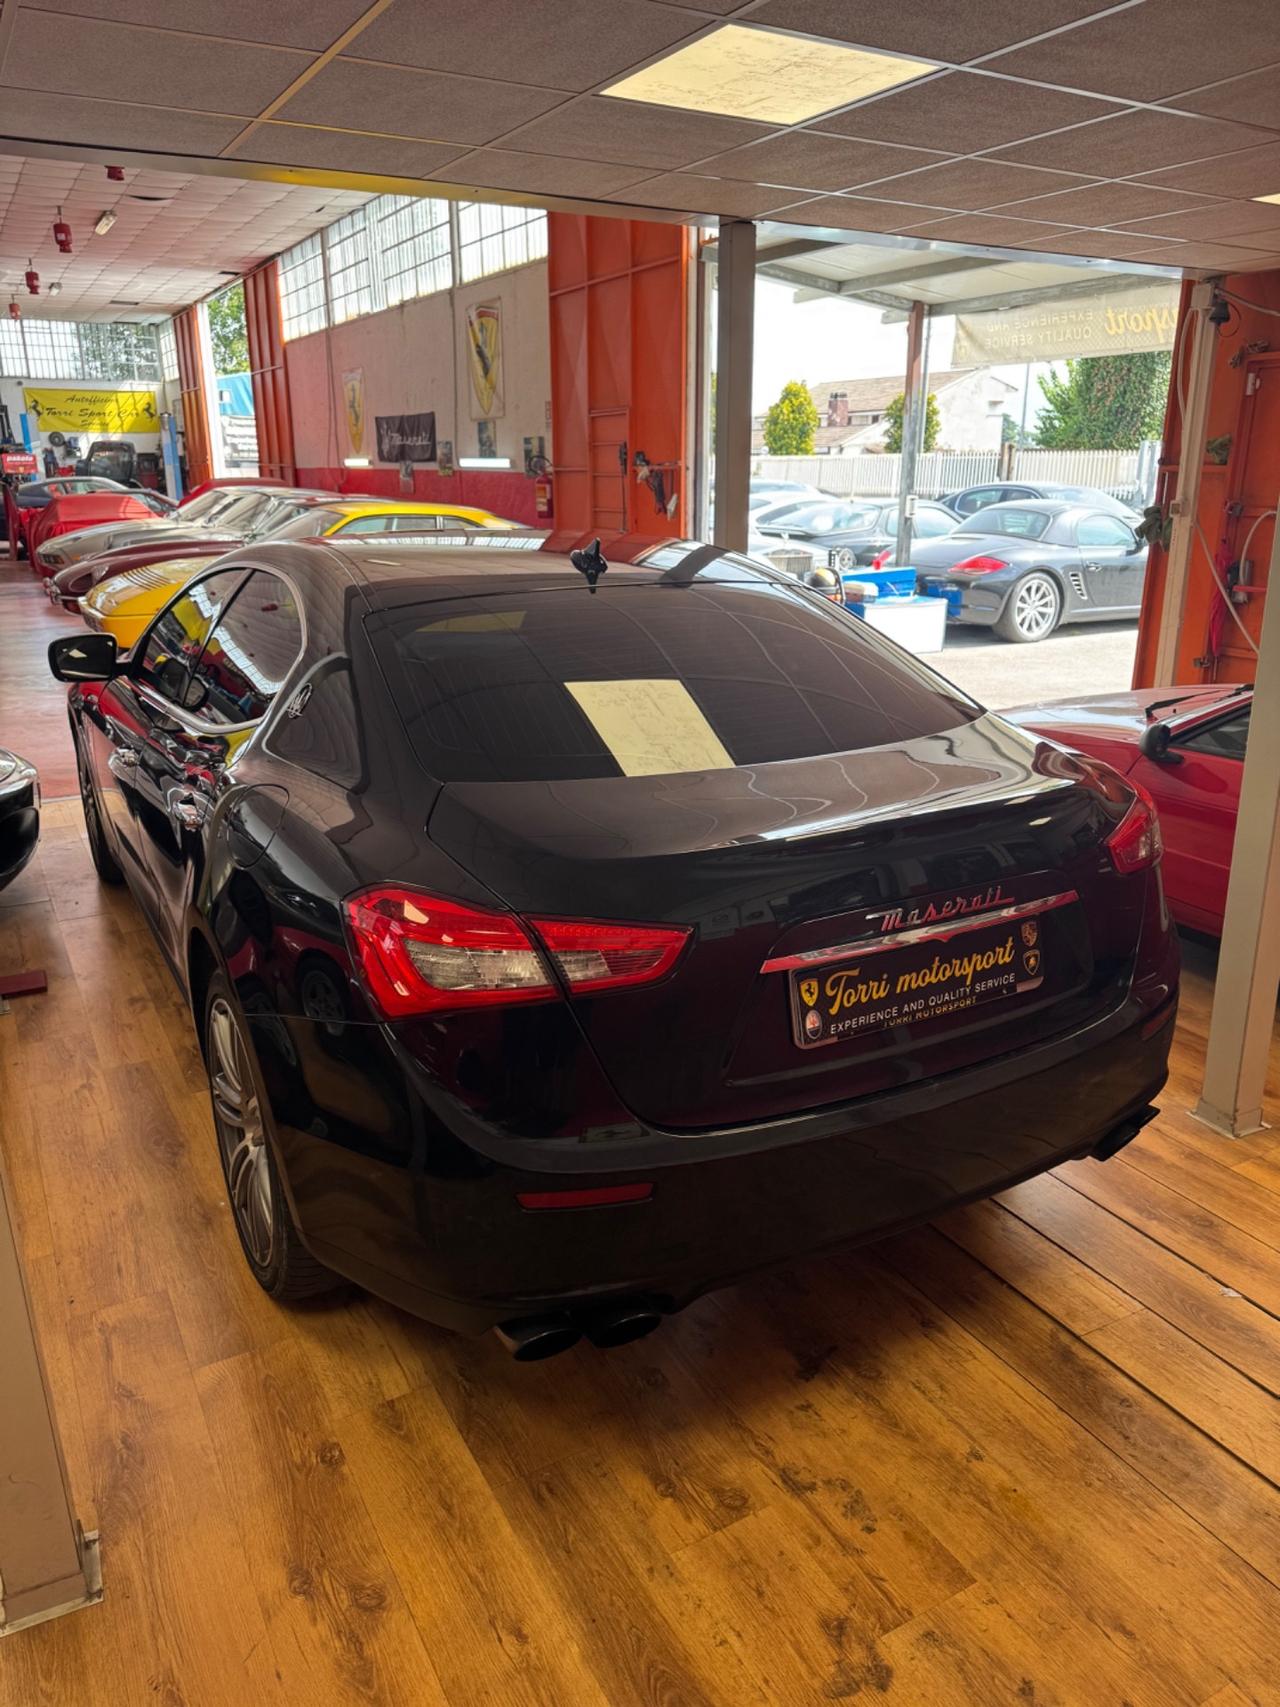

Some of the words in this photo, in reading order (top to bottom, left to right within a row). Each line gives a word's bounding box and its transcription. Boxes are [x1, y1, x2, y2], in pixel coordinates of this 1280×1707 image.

[865, 885, 1015, 932] Maserati
[825, 967, 891, 1016] Torri
[896, 936, 1015, 995] motorsport
[830, 1008, 899, 1035] EXPERIENCE
[903, 999, 925, 1014] AND
[929, 985, 972, 1005] QUALITY
[974, 972, 1016, 993] SERVICE
